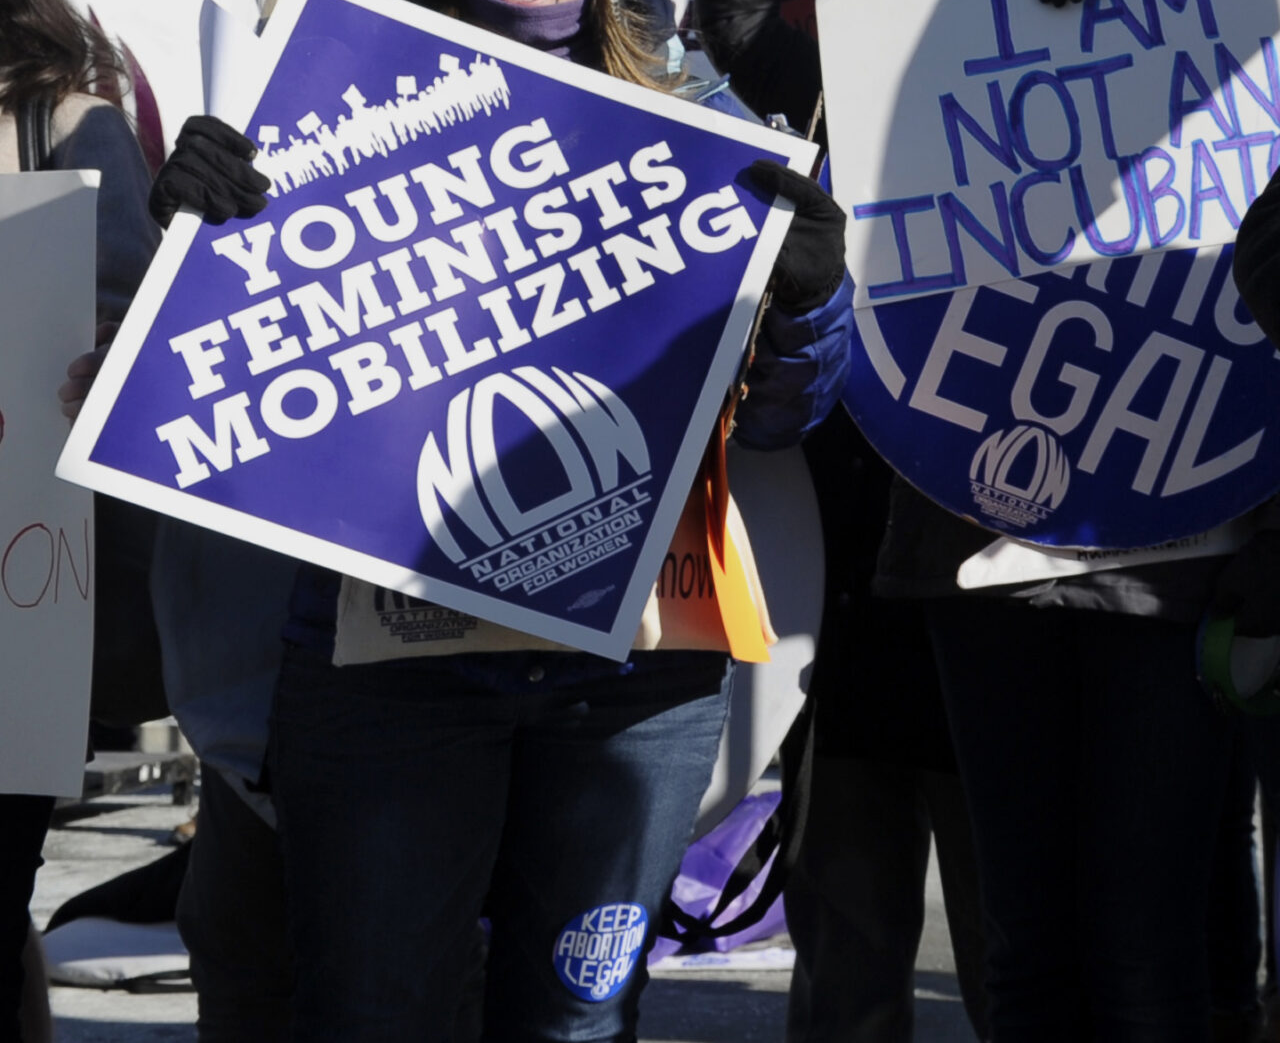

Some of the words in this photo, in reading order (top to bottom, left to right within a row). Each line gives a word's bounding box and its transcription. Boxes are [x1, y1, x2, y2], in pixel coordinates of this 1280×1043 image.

[939, 54, 1133, 187] NOT
[211, 117, 570, 297] YOUNG
[169, 141, 687, 400] FEMINISTS
[156, 184, 758, 489] MOBILIZING
[417, 365, 651, 564] NOW
[969, 425, 1070, 509] NOW
[470, 487, 649, 579] NATIONAL
[494, 509, 641, 589] ORGANIZATION
[523, 564, 559, 593] FOR
[562, 533, 629, 574] WOMEN
[559, 922, 645, 959] ABORTION
[581, 904, 641, 932] KEEP
[565, 957, 634, 987] LEGAL
